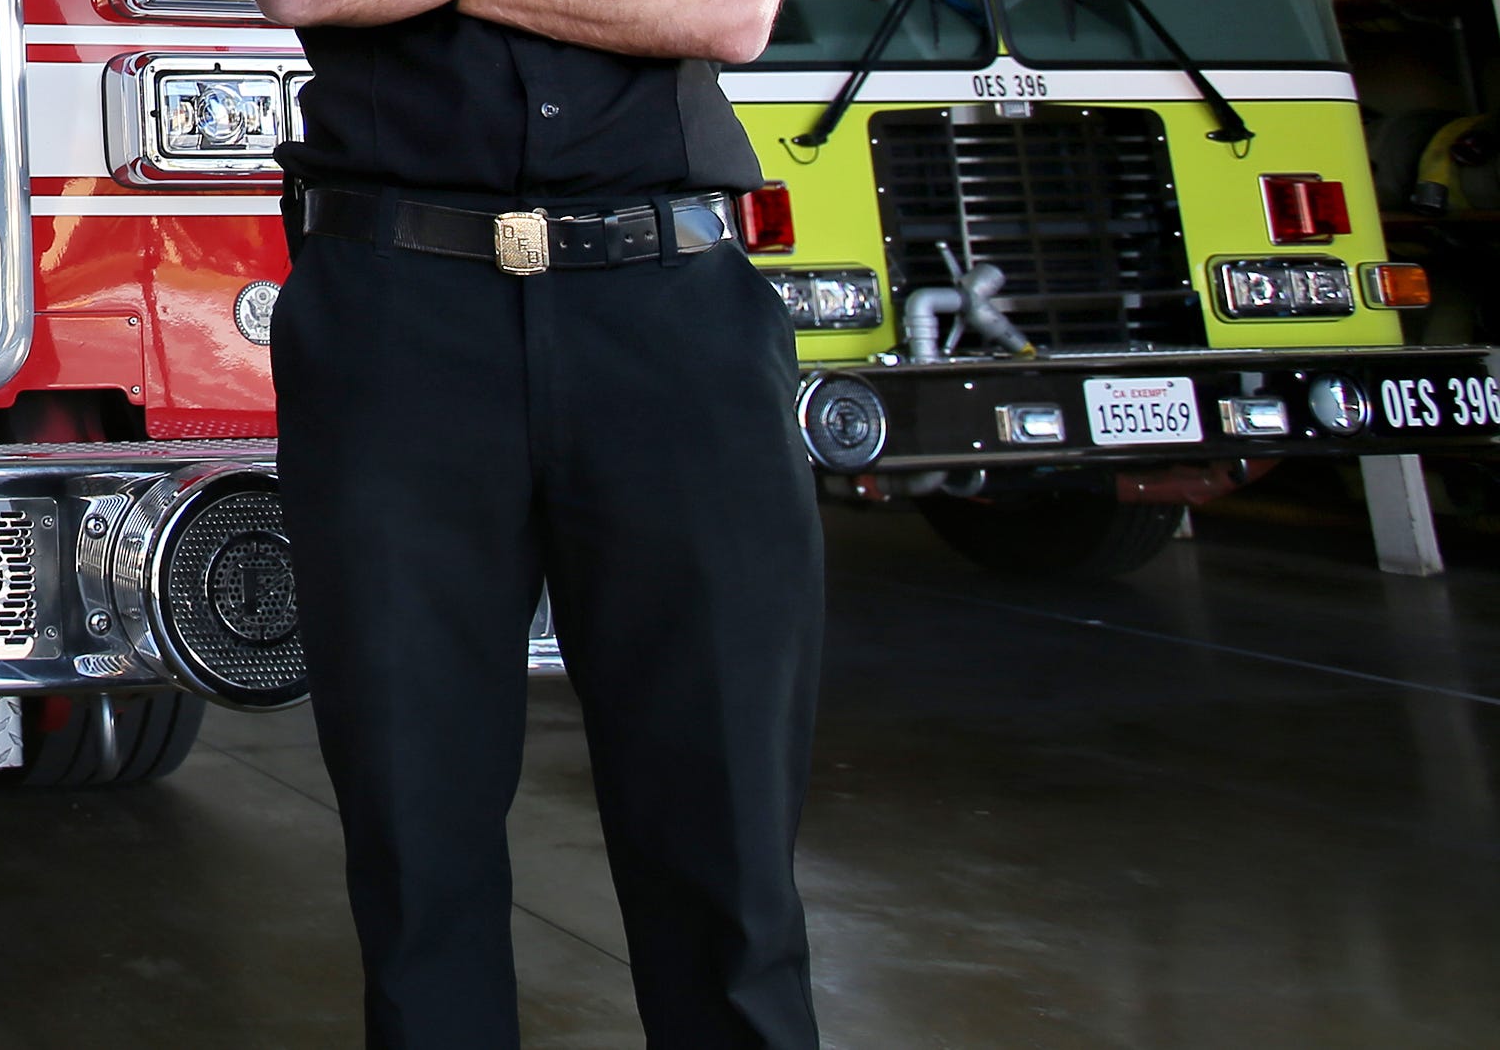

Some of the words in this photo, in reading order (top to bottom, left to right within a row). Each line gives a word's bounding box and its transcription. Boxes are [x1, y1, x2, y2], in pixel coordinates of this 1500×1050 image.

[973, 75, 1007, 97] OES
[1013, 75, 1047, 97] 396
[1112, 390, 1126, 399] CA
[1130, 388, 1168, 398] EXEMPT
[1381, 379, 1440, 428] OES
[1448, 377, 1500, 426] 396
[1098, 402, 1190, 434] 1551569
